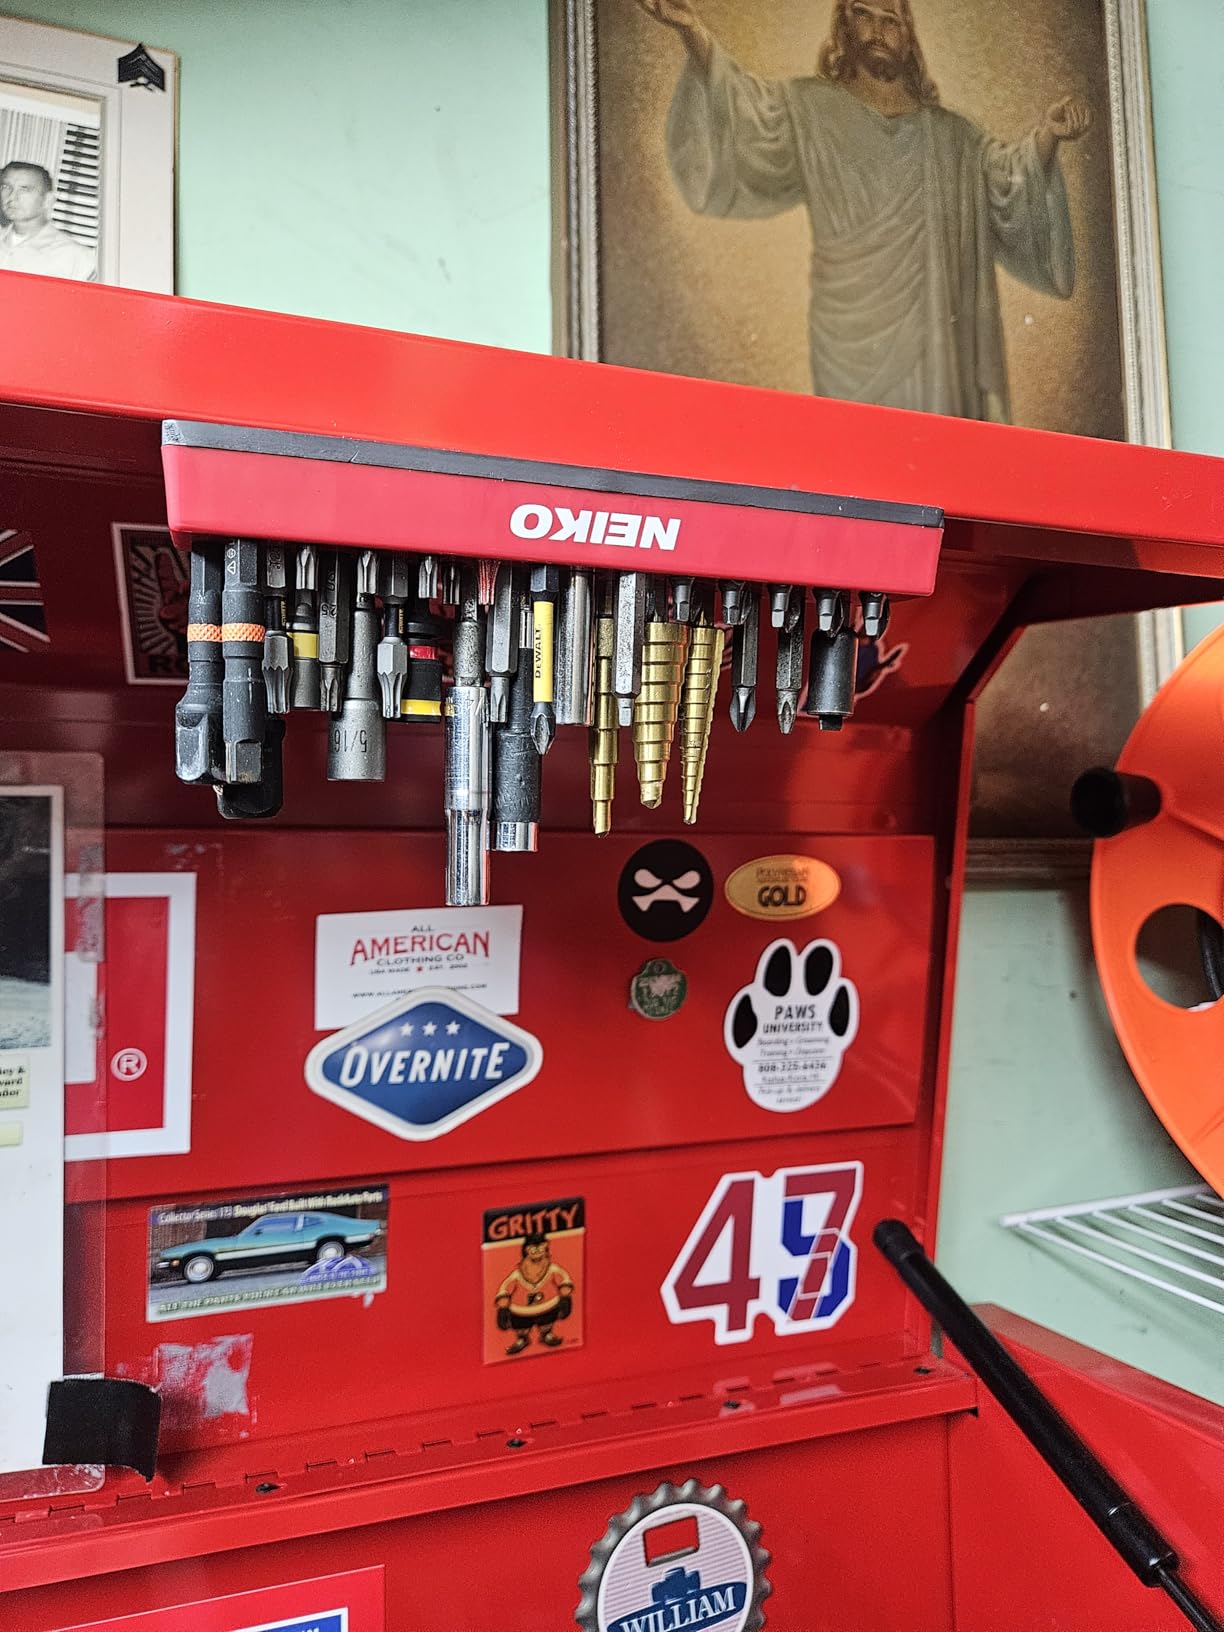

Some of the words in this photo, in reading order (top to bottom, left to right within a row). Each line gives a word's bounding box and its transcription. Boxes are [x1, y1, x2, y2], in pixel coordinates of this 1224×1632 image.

[510, 503, 682, 551] NEIKO
[334, 729, 368, 753] 5/16
[757, 885, 807, 907] GOLD
[350, 930, 490, 966] AMERICAN
[377, 954, 442, 966] CLOTHING
[446, 953, 464, 961] CO
[774, 1004, 816, 1020] PAWS
[763, 1022, 823, 1034] UNIVERSITY
[339, 1042, 510, 1088] OVERNITE
[488, 1202, 579, 1240] GRITTY
[619, 1586, 737, 1632] WILLIAM
